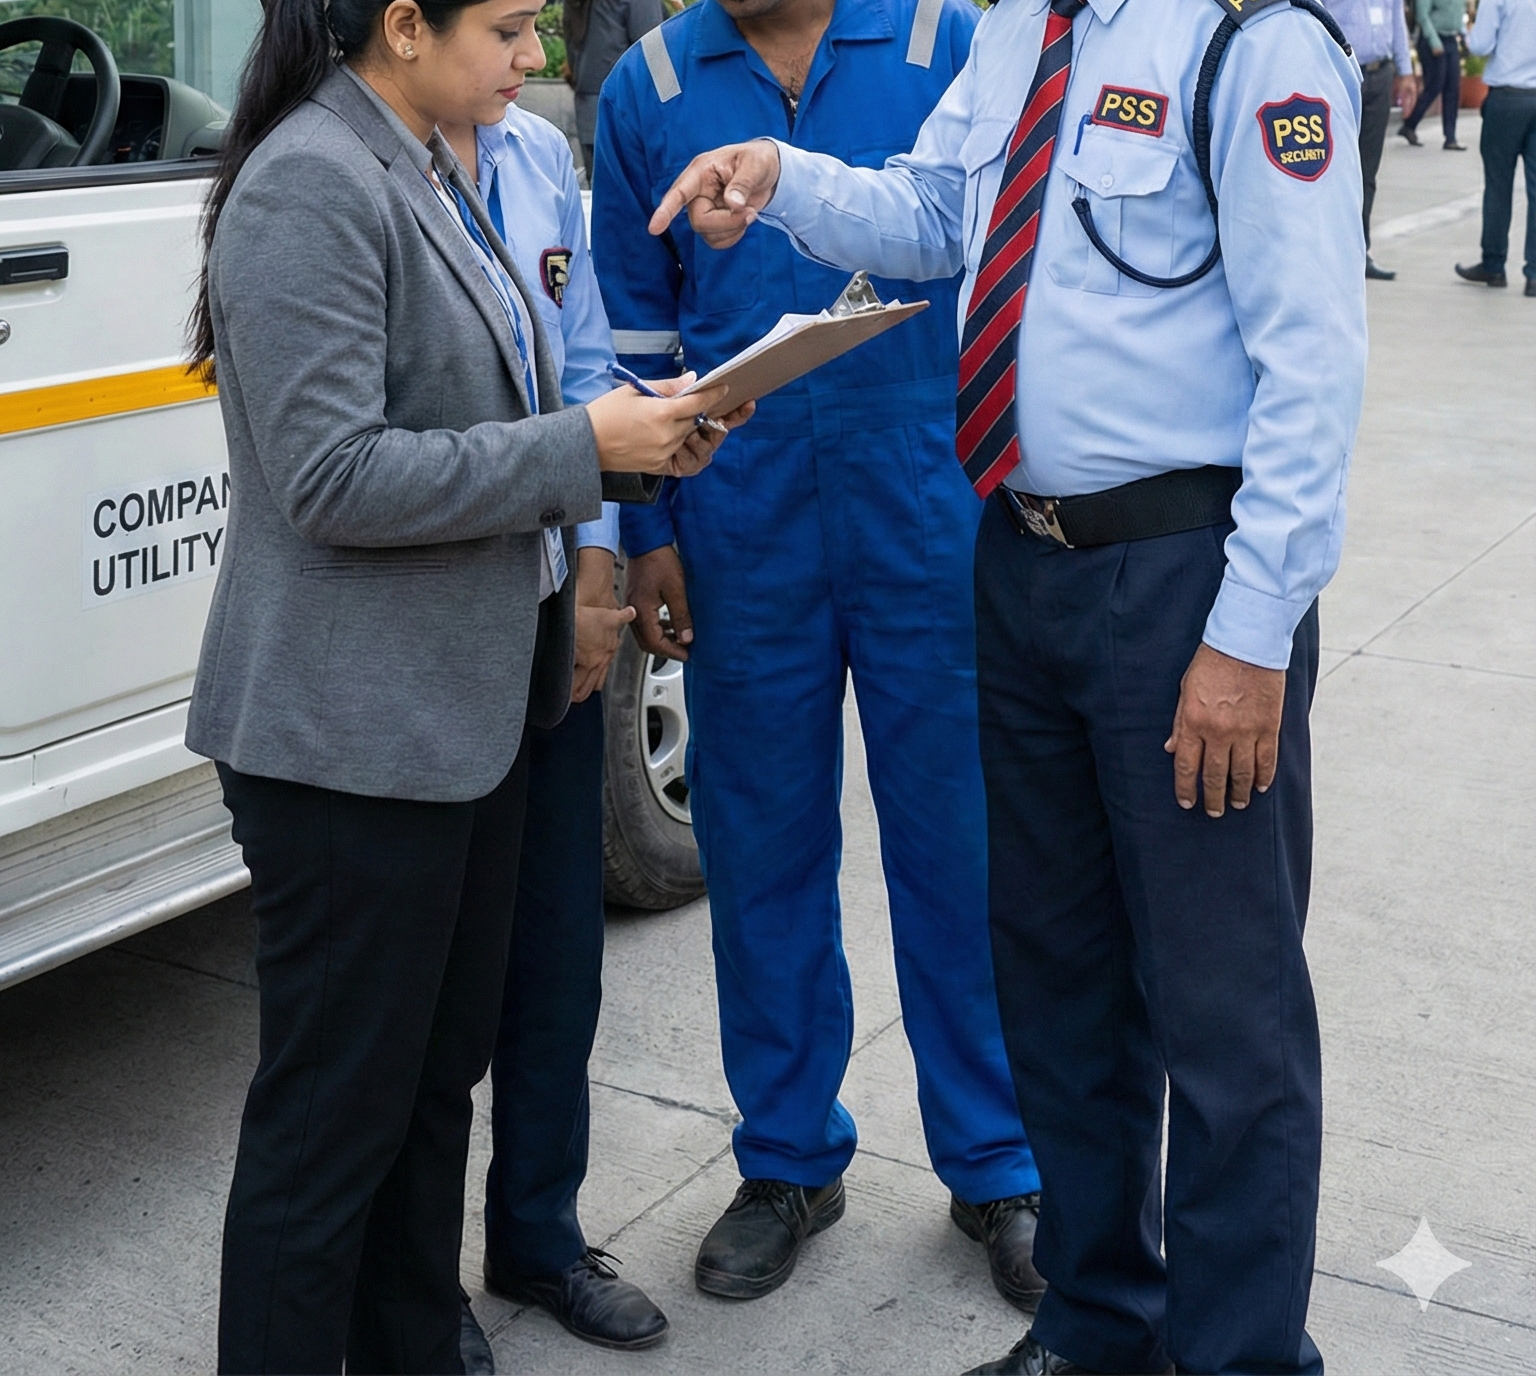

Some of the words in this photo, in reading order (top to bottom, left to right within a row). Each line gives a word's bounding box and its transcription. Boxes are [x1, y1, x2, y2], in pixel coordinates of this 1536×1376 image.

[1101, 93, 1158, 126] PSS
[1273, 114, 1325, 148] PSS
[93, 526, 225, 597] UTILITY
